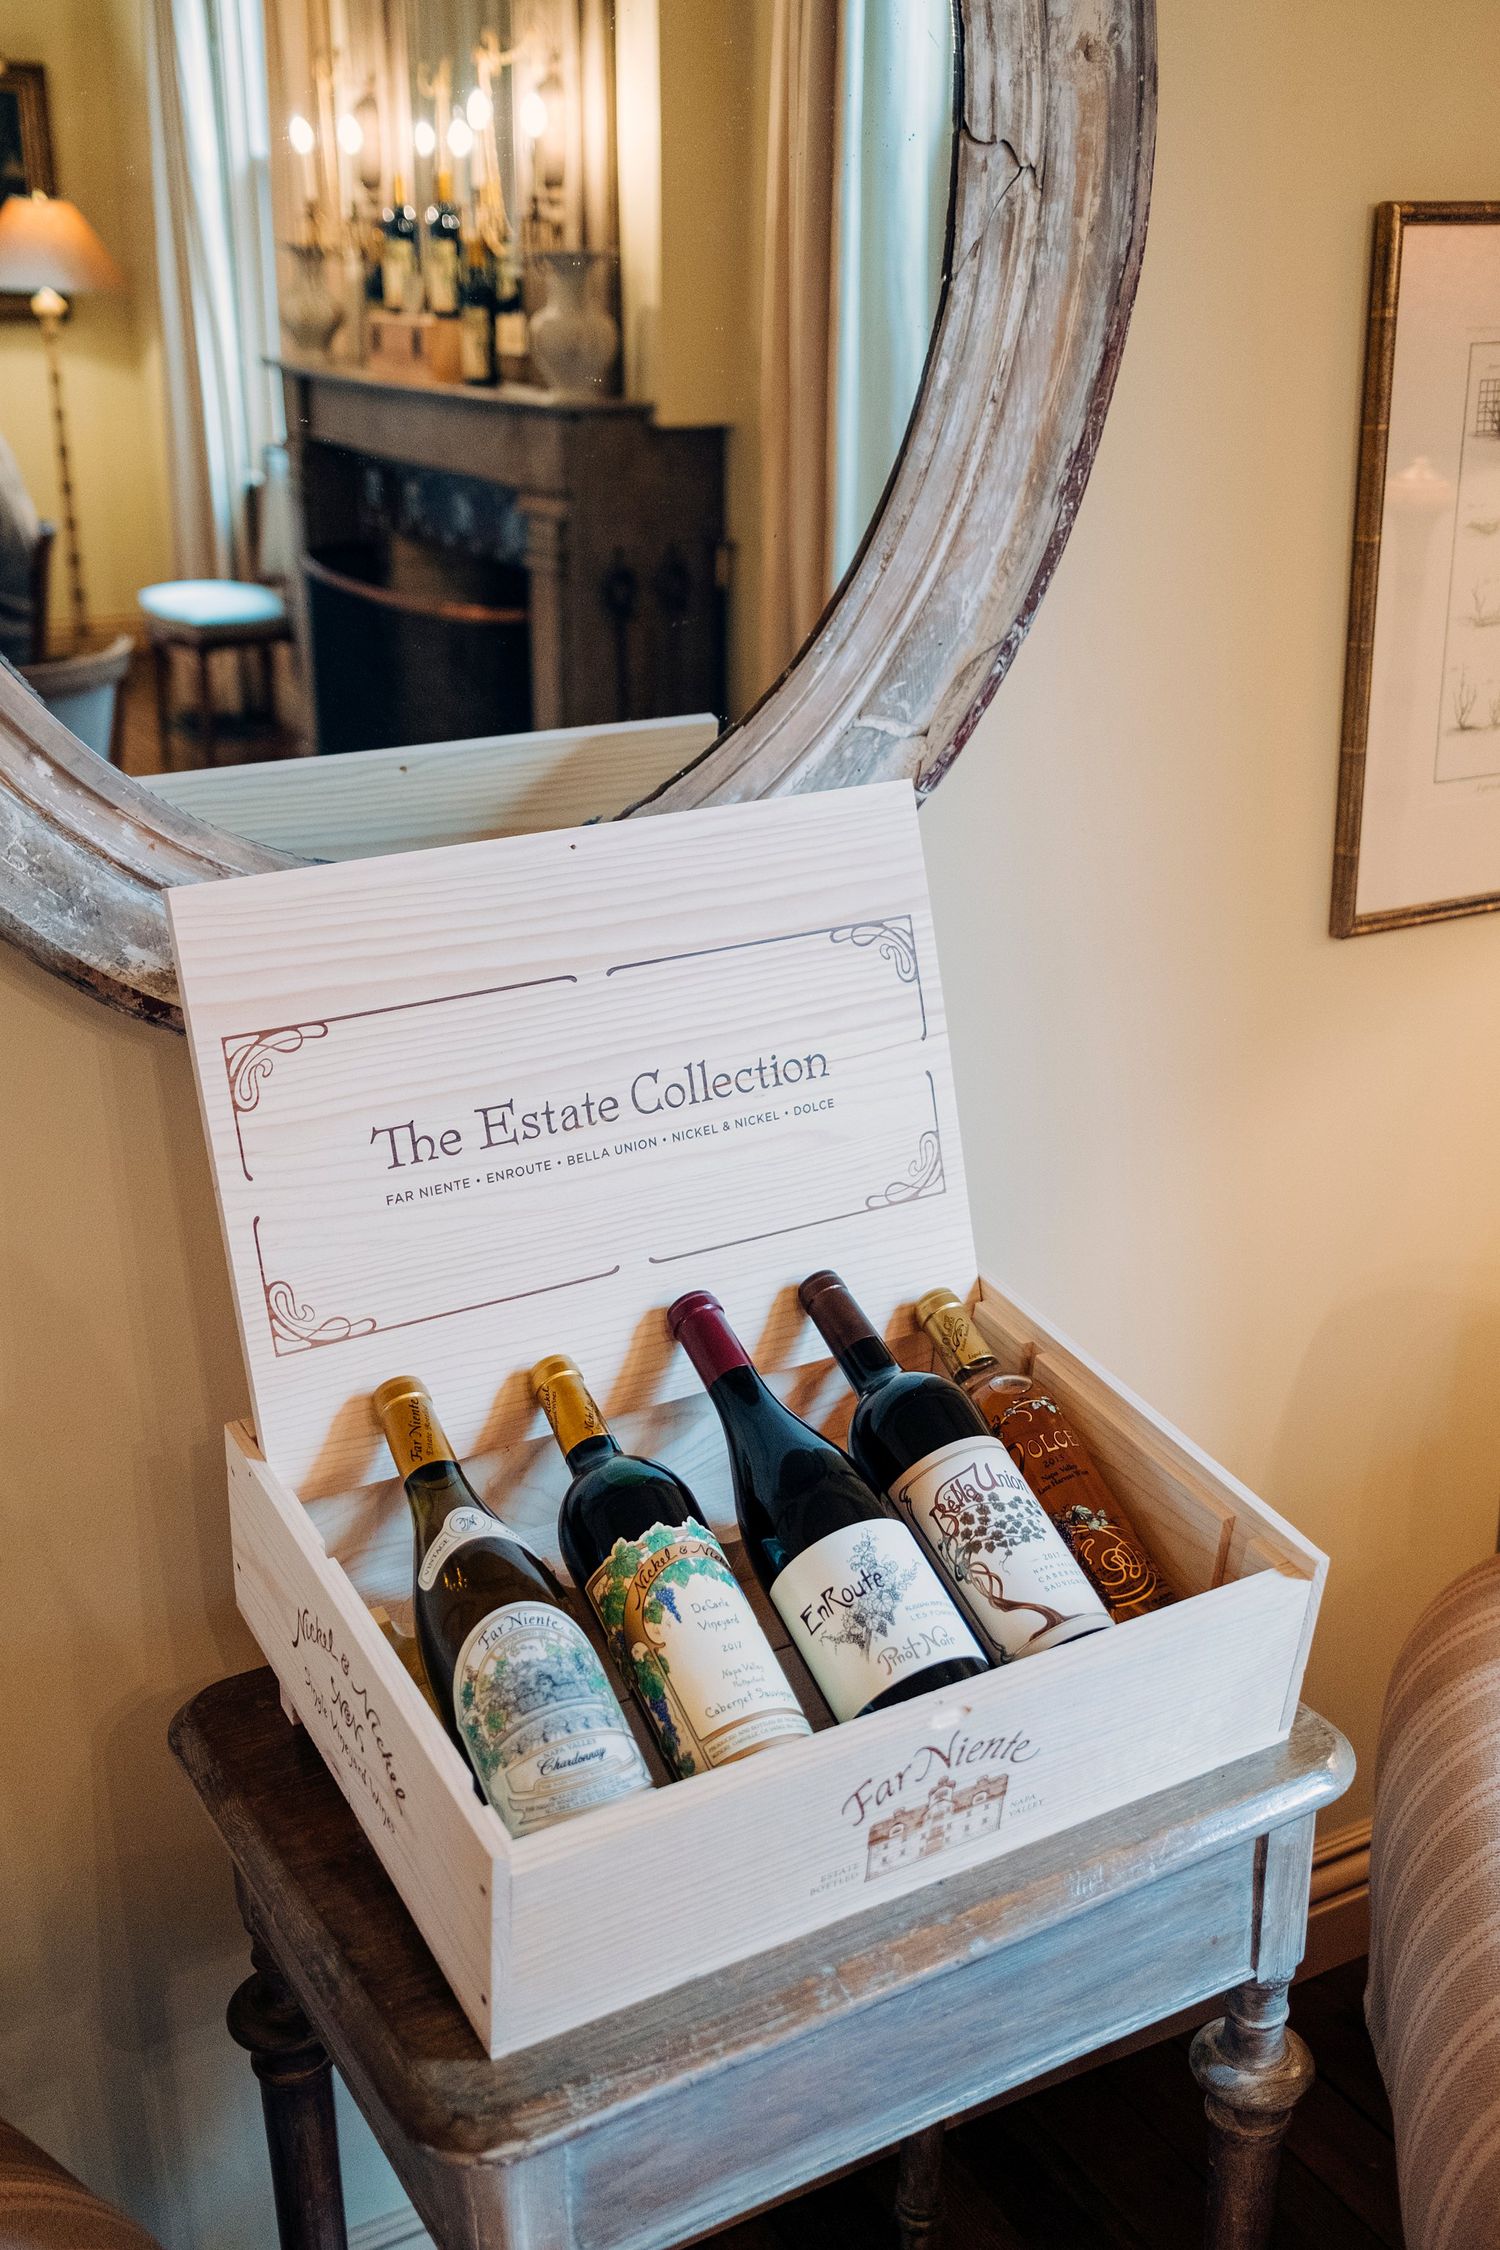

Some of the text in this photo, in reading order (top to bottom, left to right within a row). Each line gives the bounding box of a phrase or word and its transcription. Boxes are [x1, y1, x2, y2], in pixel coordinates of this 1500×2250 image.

[370, 1050, 830, 1170] The Estate Collection
[386, 1098, 835, 1206] FAR NIENTE ENROUTE BELLA UNION NICKEL & NICKEL DOLCE
[408, 1396, 423, 1462] Far Niente
[928, 1461, 1030, 1537] Bella Union
[425, 1538, 449, 1576] VINTAGE
[634, 1547, 678, 1611] Nickel
[478, 1624, 504, 1650] Far
[505, 1611, 564, 1633] Niente
[697, 1614, 740, 1633] Vineyard
[800, 1568, 885, 1636] EnRoute
[721, 1641, 743, 1653] 2017
[721, 1668, 742, 1680] Napa
[876, 1625, 956, 1676] Pinot Noir
[292, 1606, 339, 1662] Nickel
[351, 1679, 406, 1817] Nickel
[704, 1690, 754, 1719] Cabernet
[537, 1746, 607, 1776] Chardonnay
[841, 1729, 1041, 1828] Far Niente
